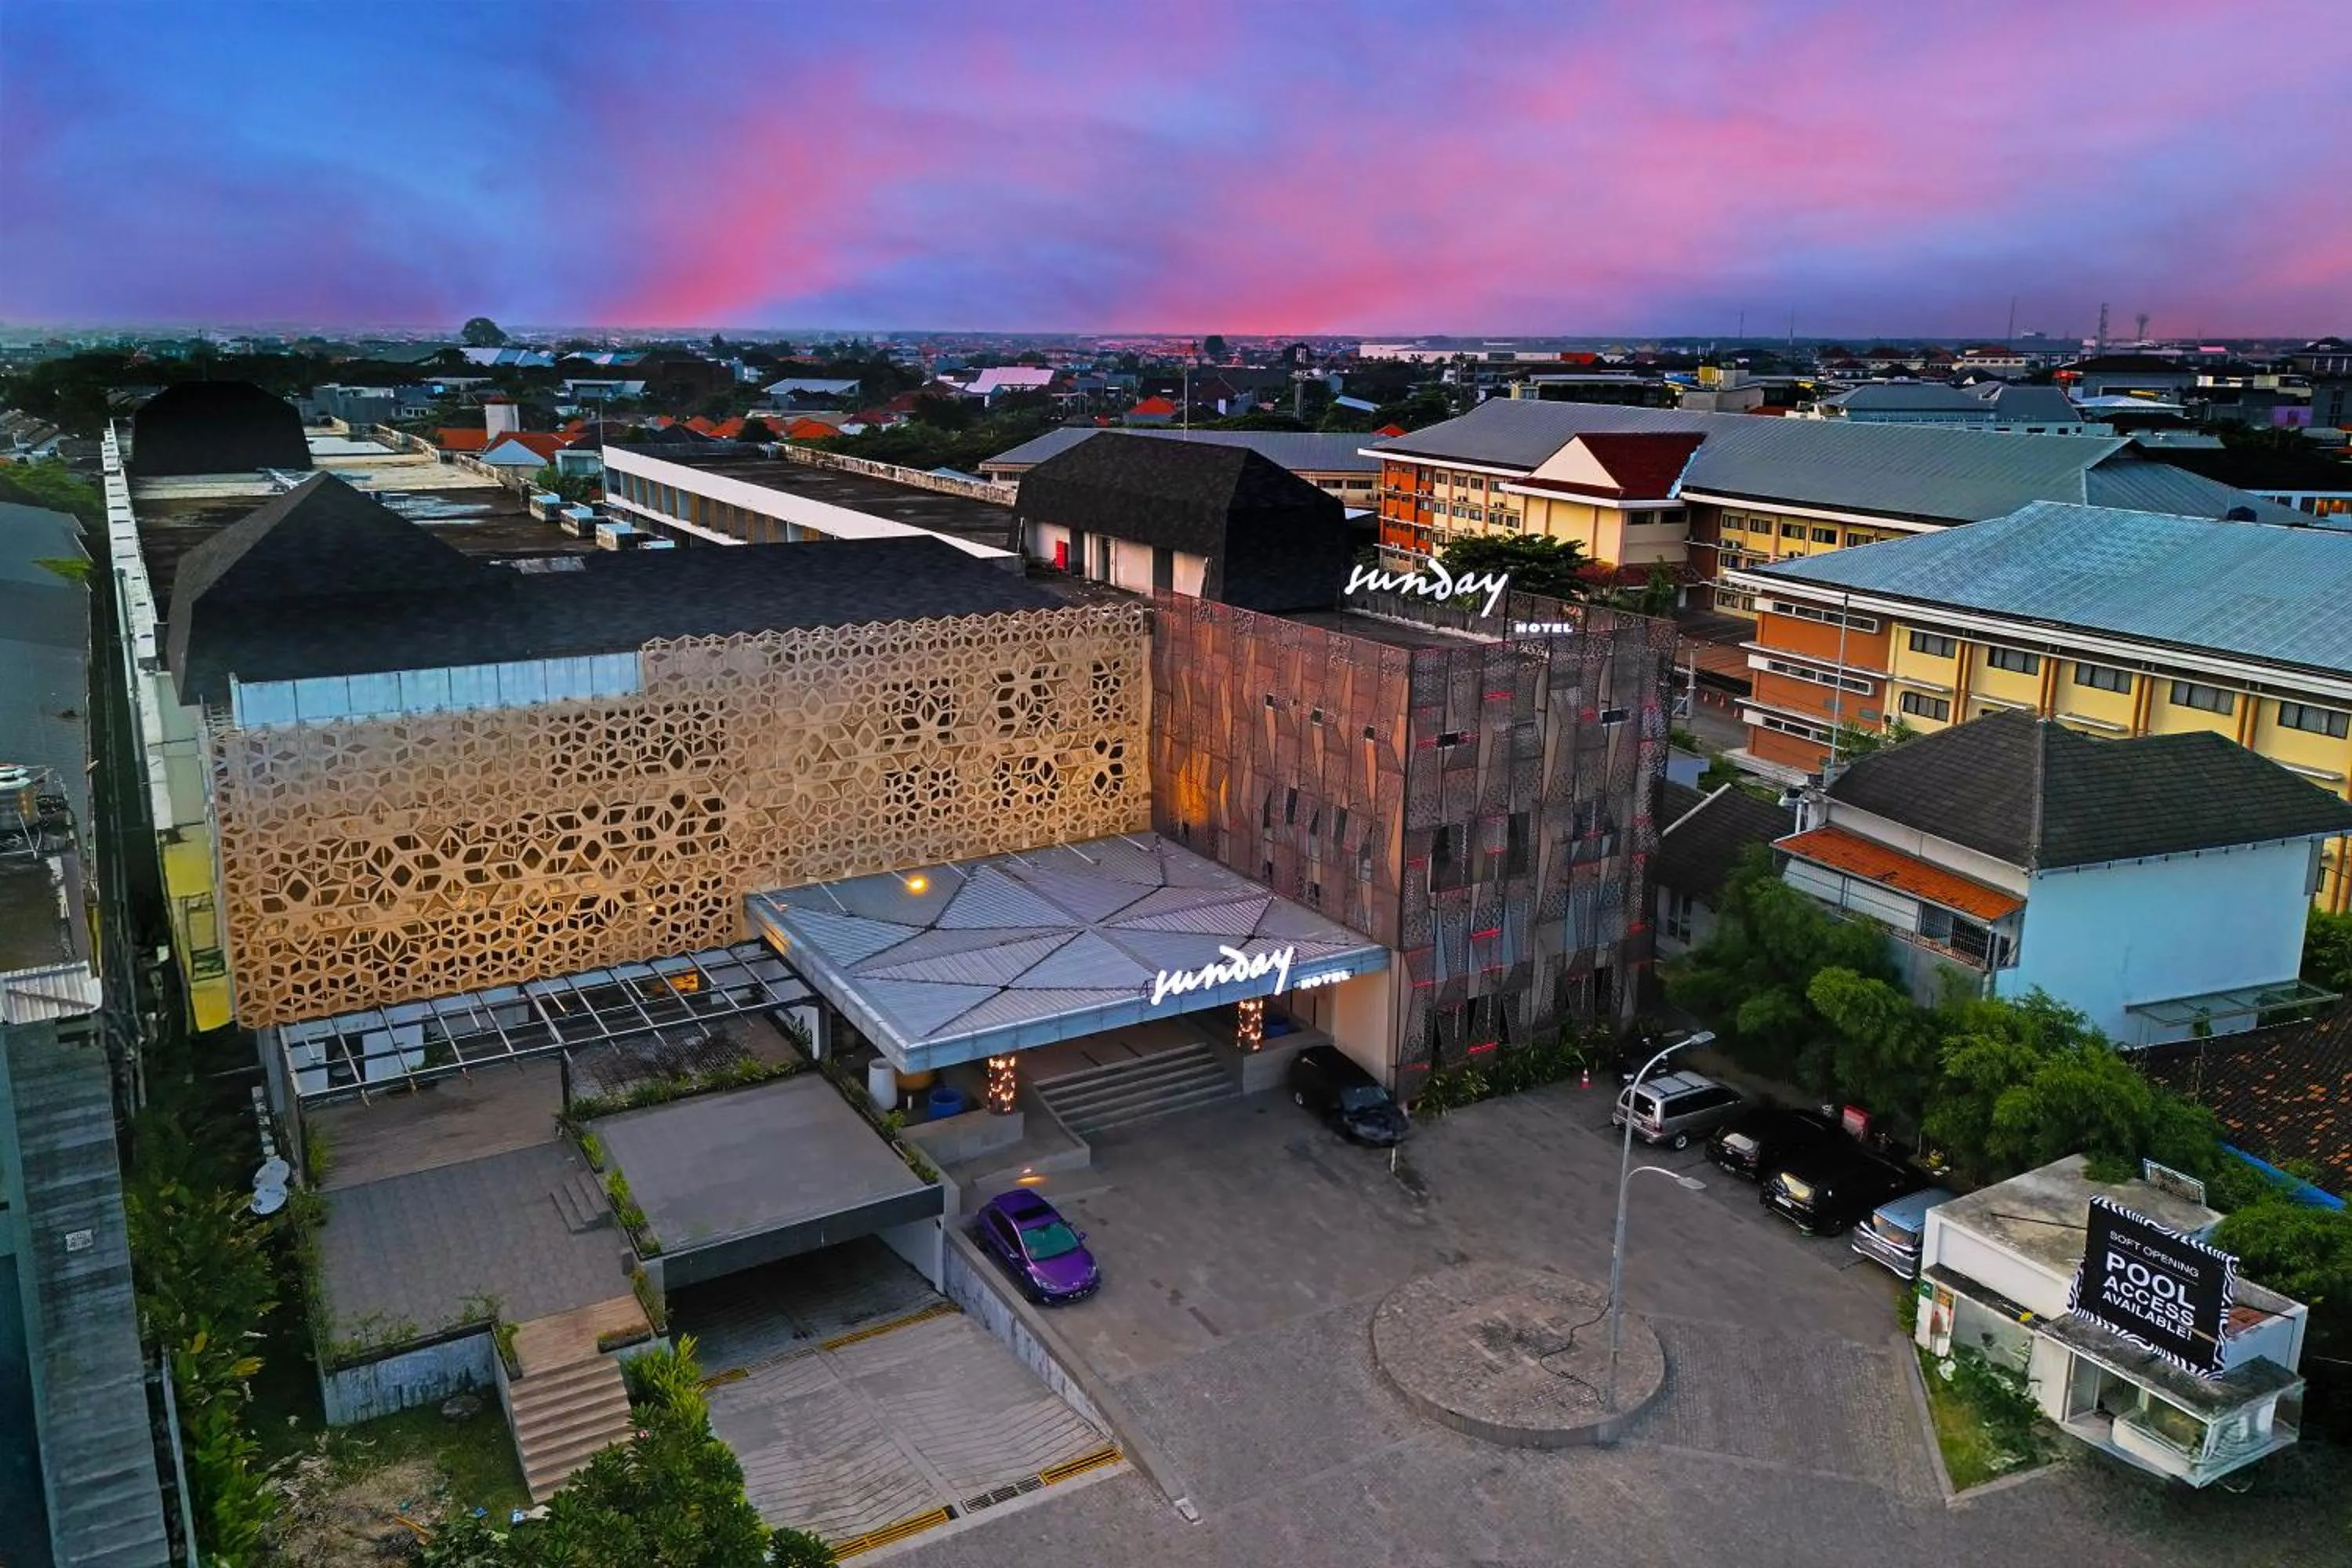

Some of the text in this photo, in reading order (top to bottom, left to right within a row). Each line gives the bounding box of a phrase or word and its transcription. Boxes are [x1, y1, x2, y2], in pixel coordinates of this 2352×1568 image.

[1345, 558, 1508, 617] sunday
[1515, 623, 1573, 633] HOTEL
[1150, 945, 1294, 1005] sunday
[1301, 971, 1351, 989] HOTEL
[2109, 1230, 2199, 1278] SOFT OPENING
[2103, 1275, 2194, 1326] ACCESS
[2106, 1250, 2195, 1311] POOL
[2102, 1290, 2191, 1341] AVAILABLE!
